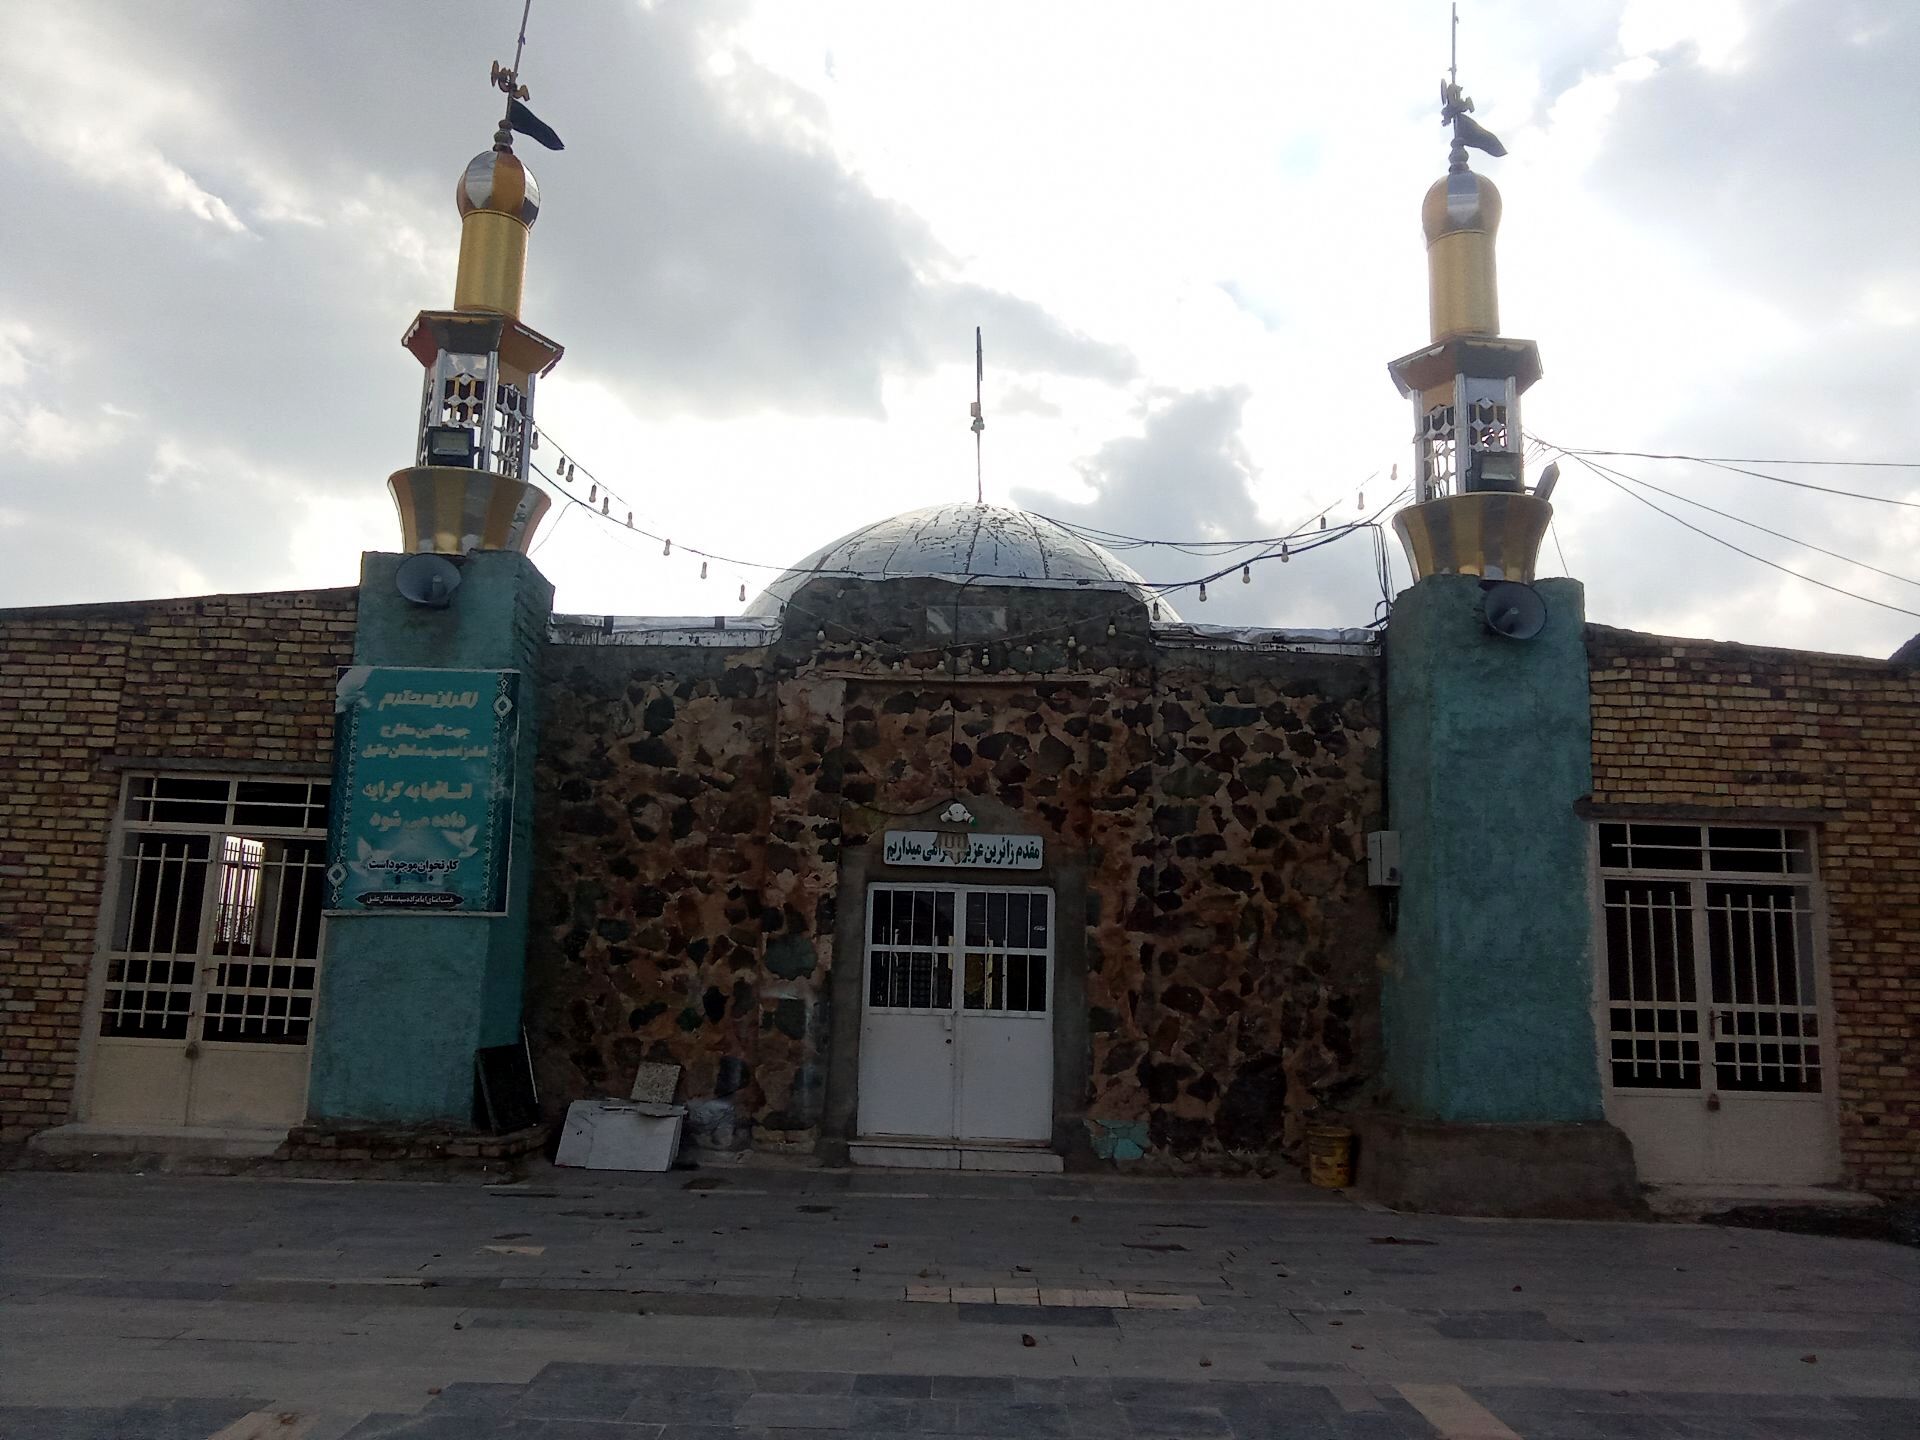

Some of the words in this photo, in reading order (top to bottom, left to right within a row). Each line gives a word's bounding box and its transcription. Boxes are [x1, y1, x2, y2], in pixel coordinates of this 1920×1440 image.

[377, 688, 432, 712] محترم
[388, 743, 425, 759] سلطان
[424, 747, 446, 760] سید
[361, 779, 405, 803] کرایه
[403, 784, 422, 803] به
[369, 809, 402, 833] شود
[402, 816, 431, 832] می
[431, 811, 467, 829] داده
[984, 836, 1015, 866] زائرین
[1015, 840, 1041, 866] مقدم
[368, 859, 390, 870] است
[389, 859, 418, 873] موجود
[417, 859, 459, 874] کارتخوان
